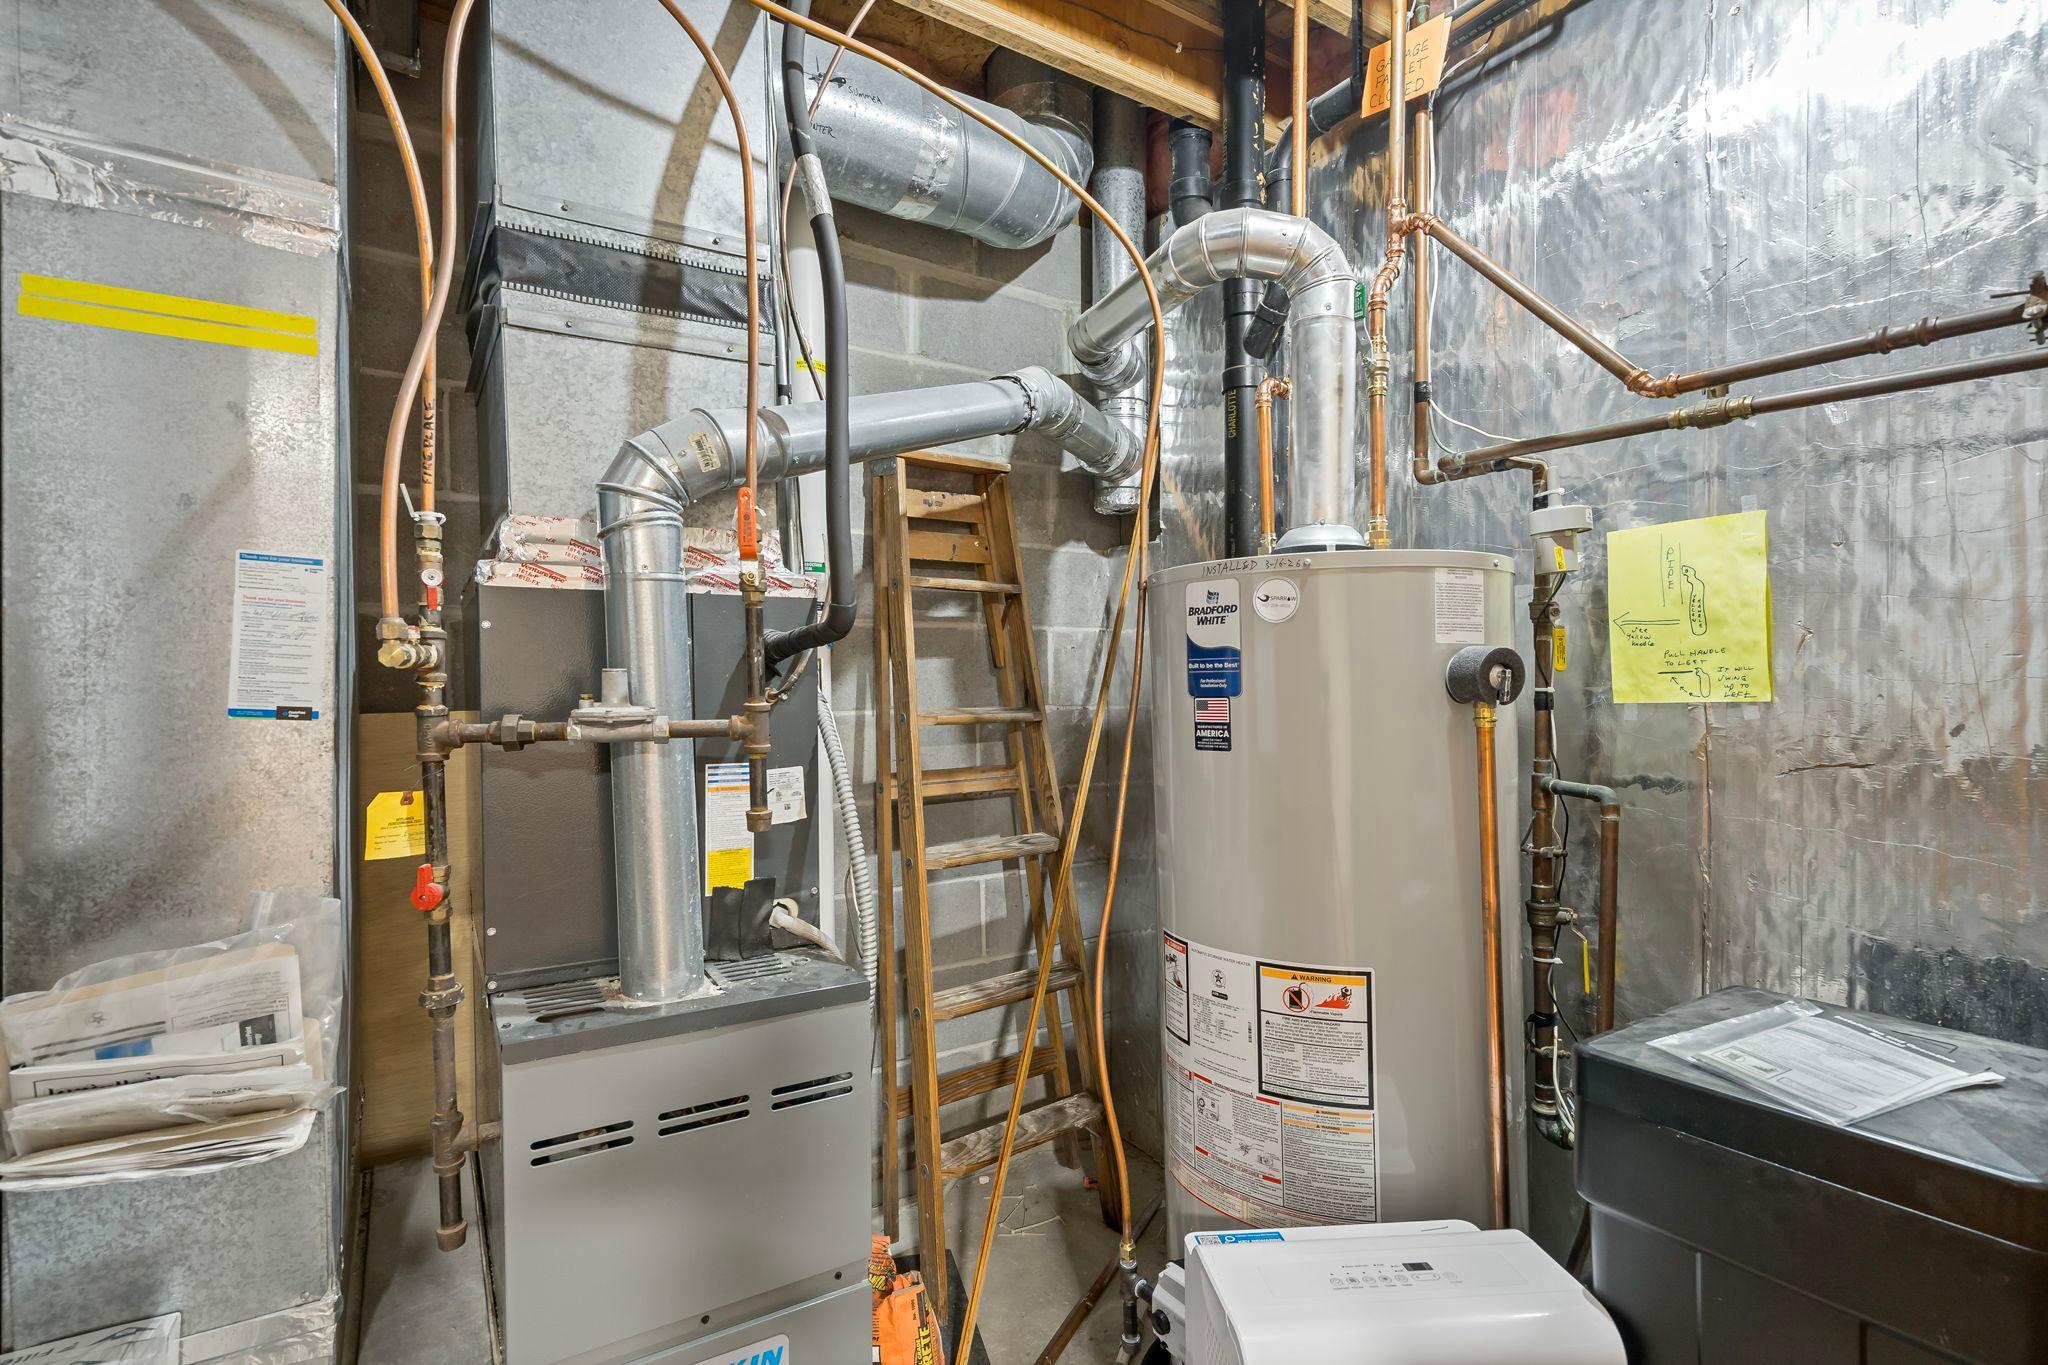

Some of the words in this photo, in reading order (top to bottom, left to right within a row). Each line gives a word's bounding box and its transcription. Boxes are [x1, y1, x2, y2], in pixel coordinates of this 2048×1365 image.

[1376, 38, 1429, 72] GAAGE
[1376, 56, 1429, 88] FAET
[1227, 388, 1237, 438] CHARLOTTE
[422, 396, 436, 485] FIREPLACE
[1201, 560, 1257, 577] INSTALLED
[1666, 546, 1674, 590] PIPE
[1188, 604, 1238, 616] BRADFORD
[1196, 615, 1227, 626] WHITE
[1689, 648, 1727, 657] HANDLE
[1196, 729, 1230, 738] AMERICA
[1299, 974, 1332, 984] WARNING
